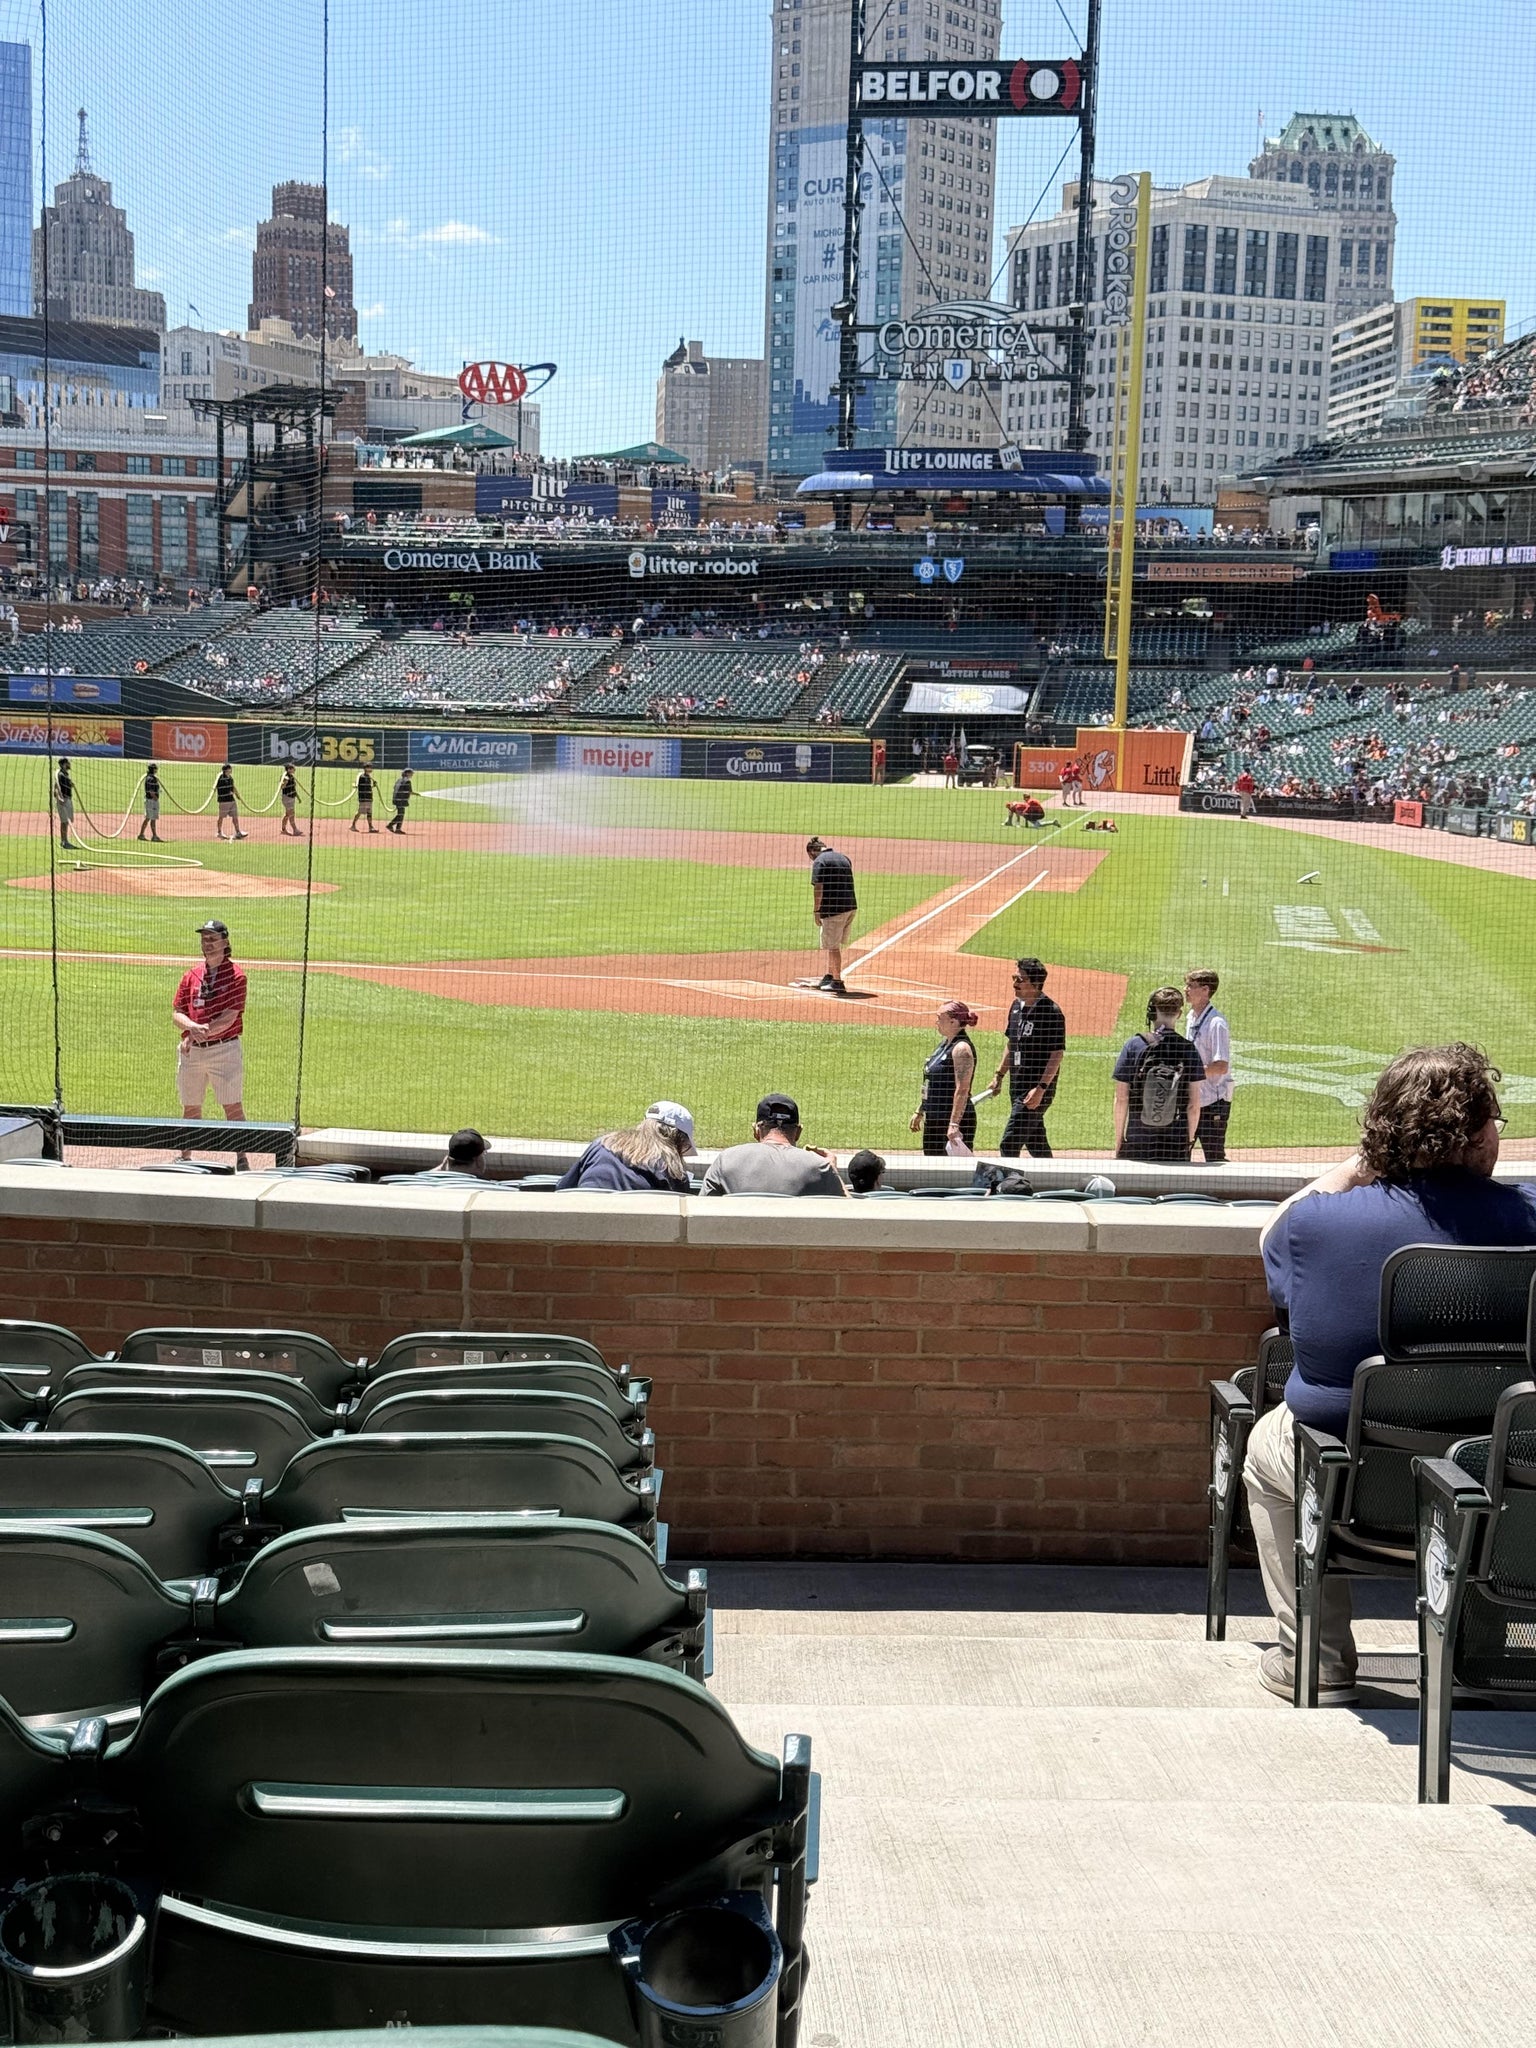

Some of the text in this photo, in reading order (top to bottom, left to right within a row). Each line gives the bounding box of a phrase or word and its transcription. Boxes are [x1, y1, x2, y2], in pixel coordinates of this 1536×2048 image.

[861, 70, 1002, 101] BELFOR
[1104, 207, 1137, 327] Rocket
[878, 361, 1040, 382] LANDING
[460, 366, 526, 403] AAA
[884, 449, 993, 475] Lite LOUNGE
[530, 473, 569, 502] Lite
[501, 499, 594, 516] PITCHER'S PUB
[667, 496, 687, 511] Lite
[488, 551, 544, 571] Bank
[929, 661, 950, 669] PLAY
[941, 669, 1011, 679] LOTTERY GAMES
[0, 720, 70, 745] Surfside
[270, 732, 375, 762] bet365
[447, 737, 518, 756] McLaren
[440, 759, 500, 769] HEALTH CARE
[582, 743, 654, 774] meijer
[726, 757, 782, 776] Corona
